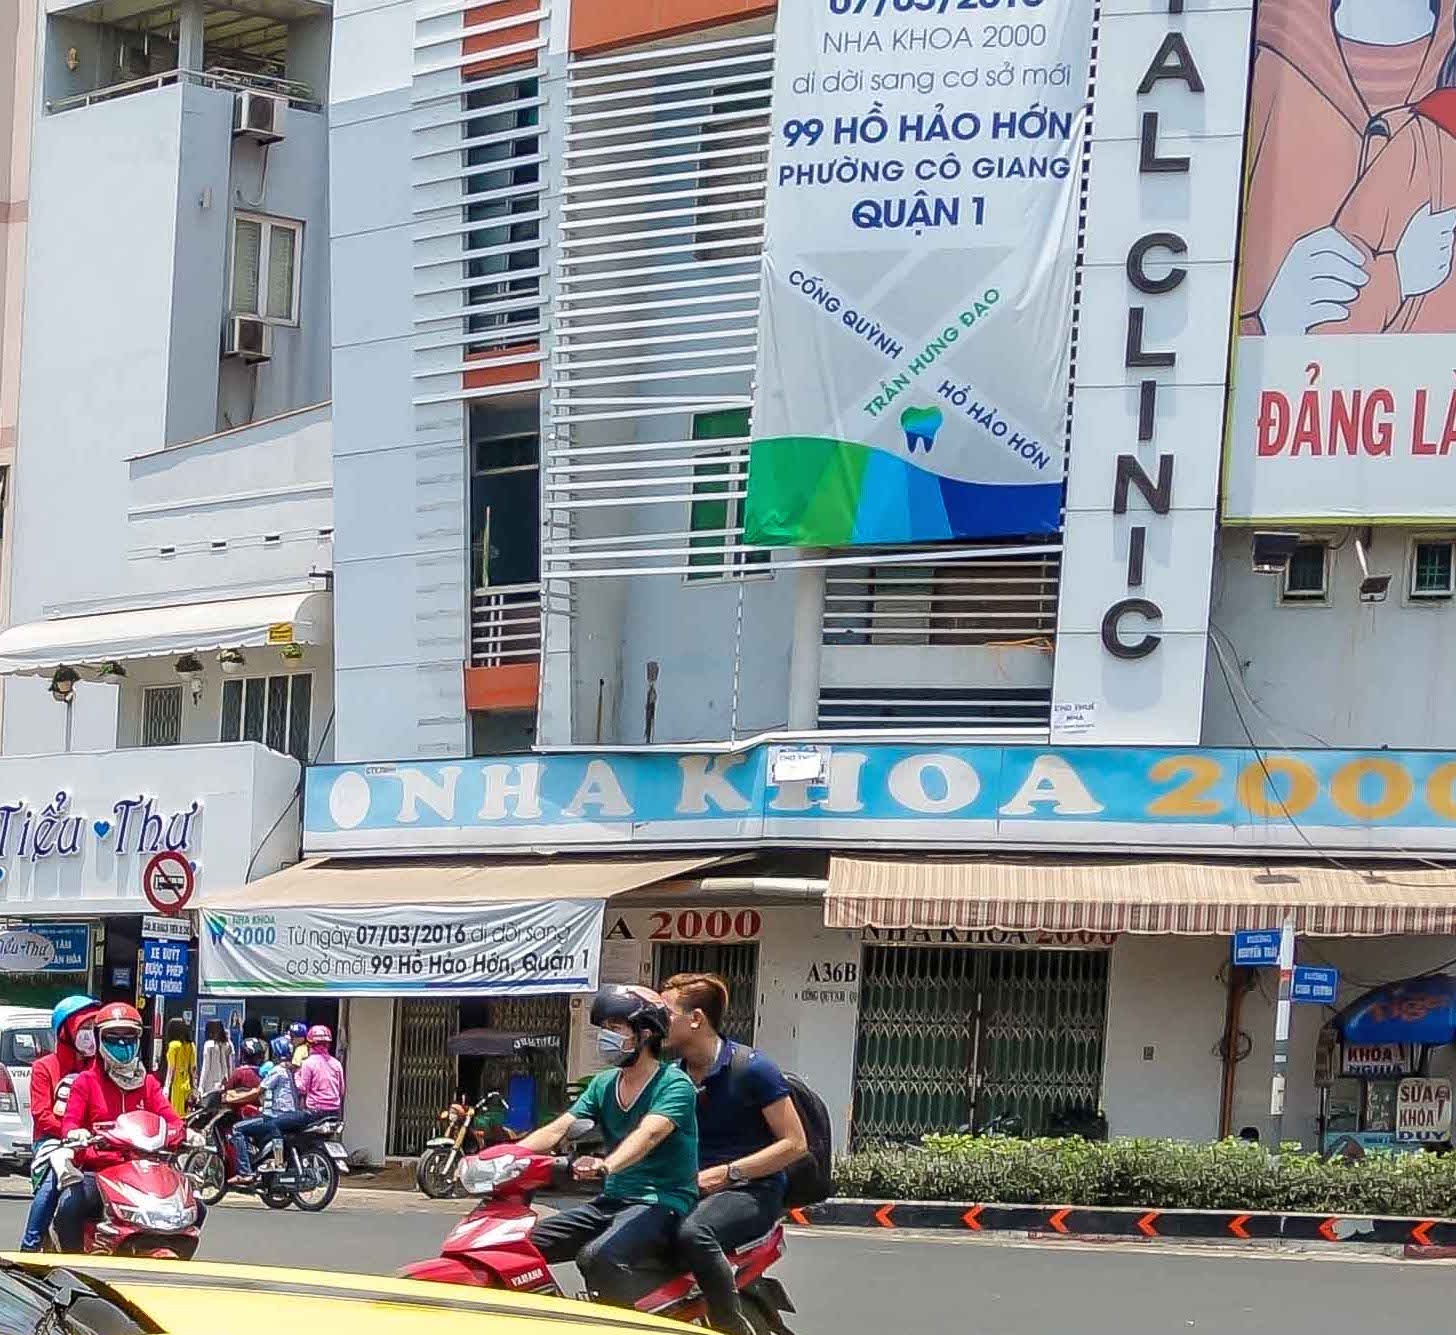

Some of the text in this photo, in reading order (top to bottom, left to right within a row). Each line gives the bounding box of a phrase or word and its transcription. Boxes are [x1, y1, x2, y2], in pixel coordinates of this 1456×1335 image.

[823, 24, 1047, 54] NHA KHOA 2000
[792, 61, 1072, 95] di dời sang cơ sở mới
[1136, 0, 1206, 173] AL
[782, 100, 1073, 147] 99 HỒ HẢO HỚN
[779, 152, 1071, 187] PHƯỜNG CÔ GIANG
[851, 189, 985, 237] QUẬN 1
[788, 269, 904, 360] CỐNG QUỲNH
[863, 287, 1000, 418] TRẦN HƯNG ĐẠO
[938, 379, 1051, 471] HỒ HẢO HỚN
[1256, 361, 1396, 457] ĐẢNG
[1100, 231, 1189, 660] CLINIC
[394, 757, 635, 822] NHA
[676, 750, 1105, 818] KHOA
[113, 794, 199, 853] Thư
[234, 926, 277, 945] 2000
[310, 926, 353, 950] ngày
[356, 924, 466, 948] 07/03/2016
[526, 922, 572, 946] sang
[648, 908, 762, 940] 2000
[335, 955, 366, 975] mới
[370, 954, 394, 975] 99
[398, 950, 423, 975] Hồ
[429, 951, 467, 975] Hảo
[522, 950, 575, 977] Quận
[806, 961, 858, 984] A36B
[1398, 1131, 1446, 1141] DUY
